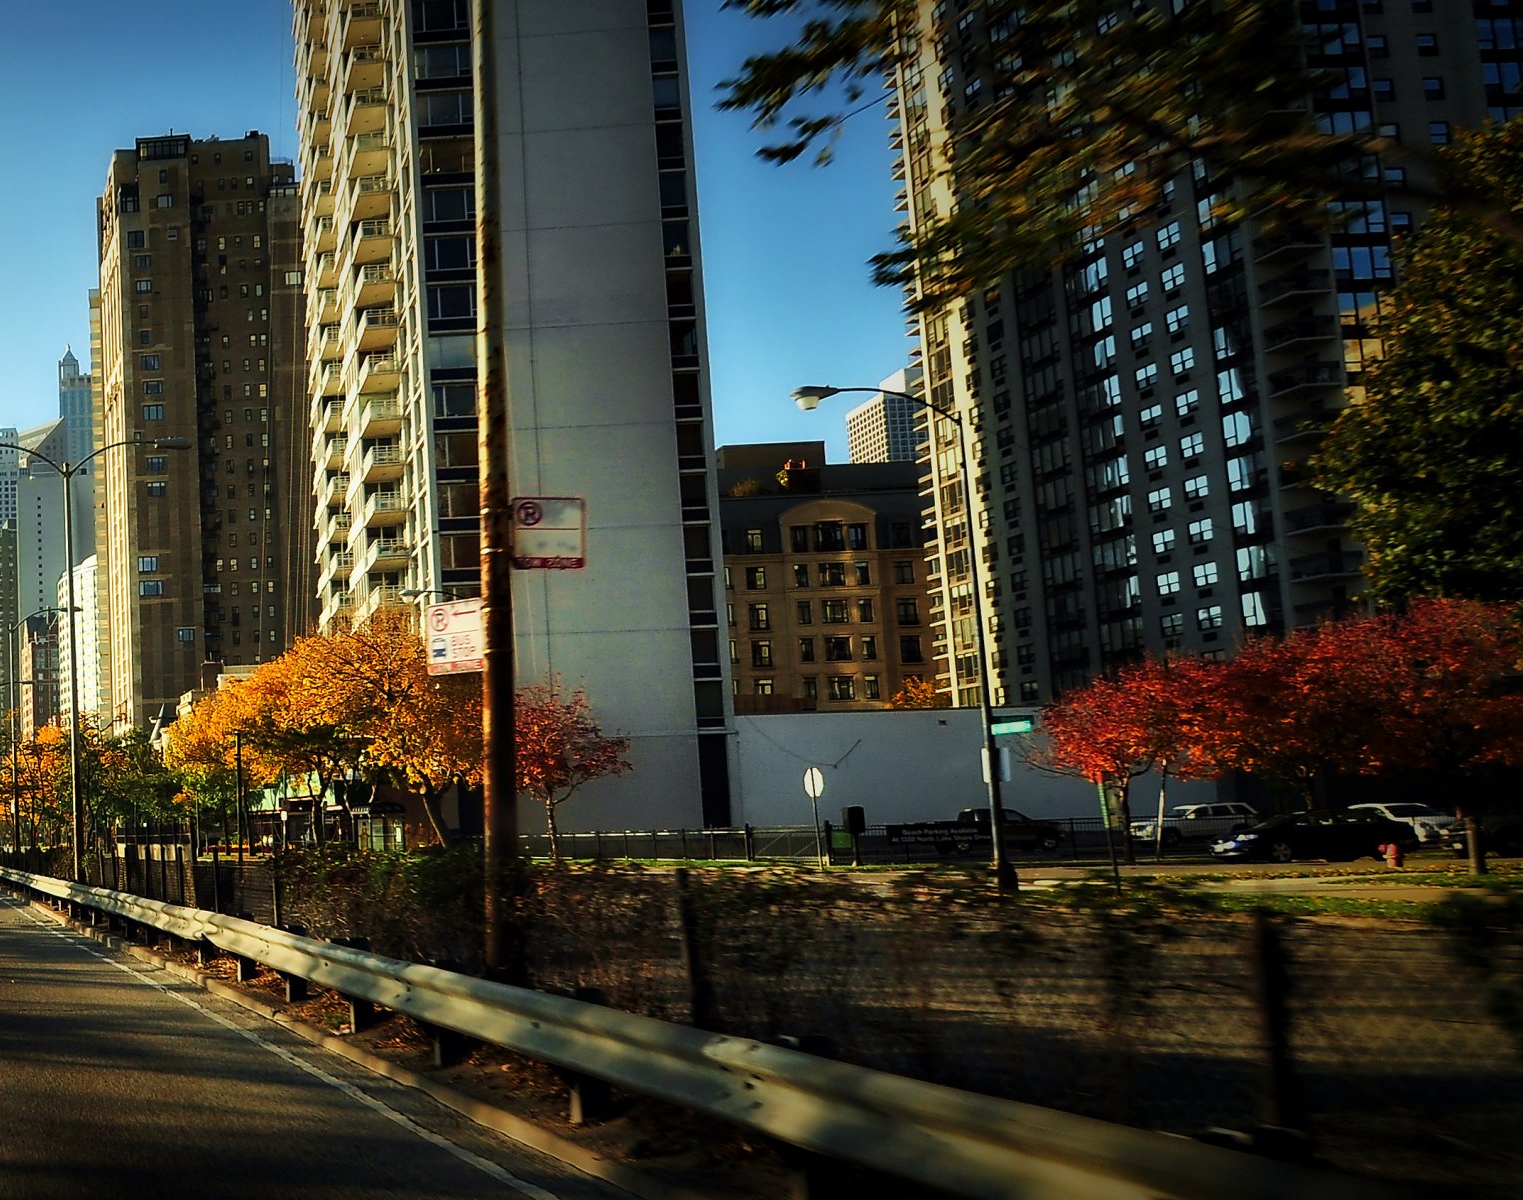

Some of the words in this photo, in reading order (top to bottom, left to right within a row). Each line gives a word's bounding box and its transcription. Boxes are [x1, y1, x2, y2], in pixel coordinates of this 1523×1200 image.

[451, 634, 470, 647] BUS
[452, 645, 476, 658] STOP
[923, 828, 950, 836] Parking
